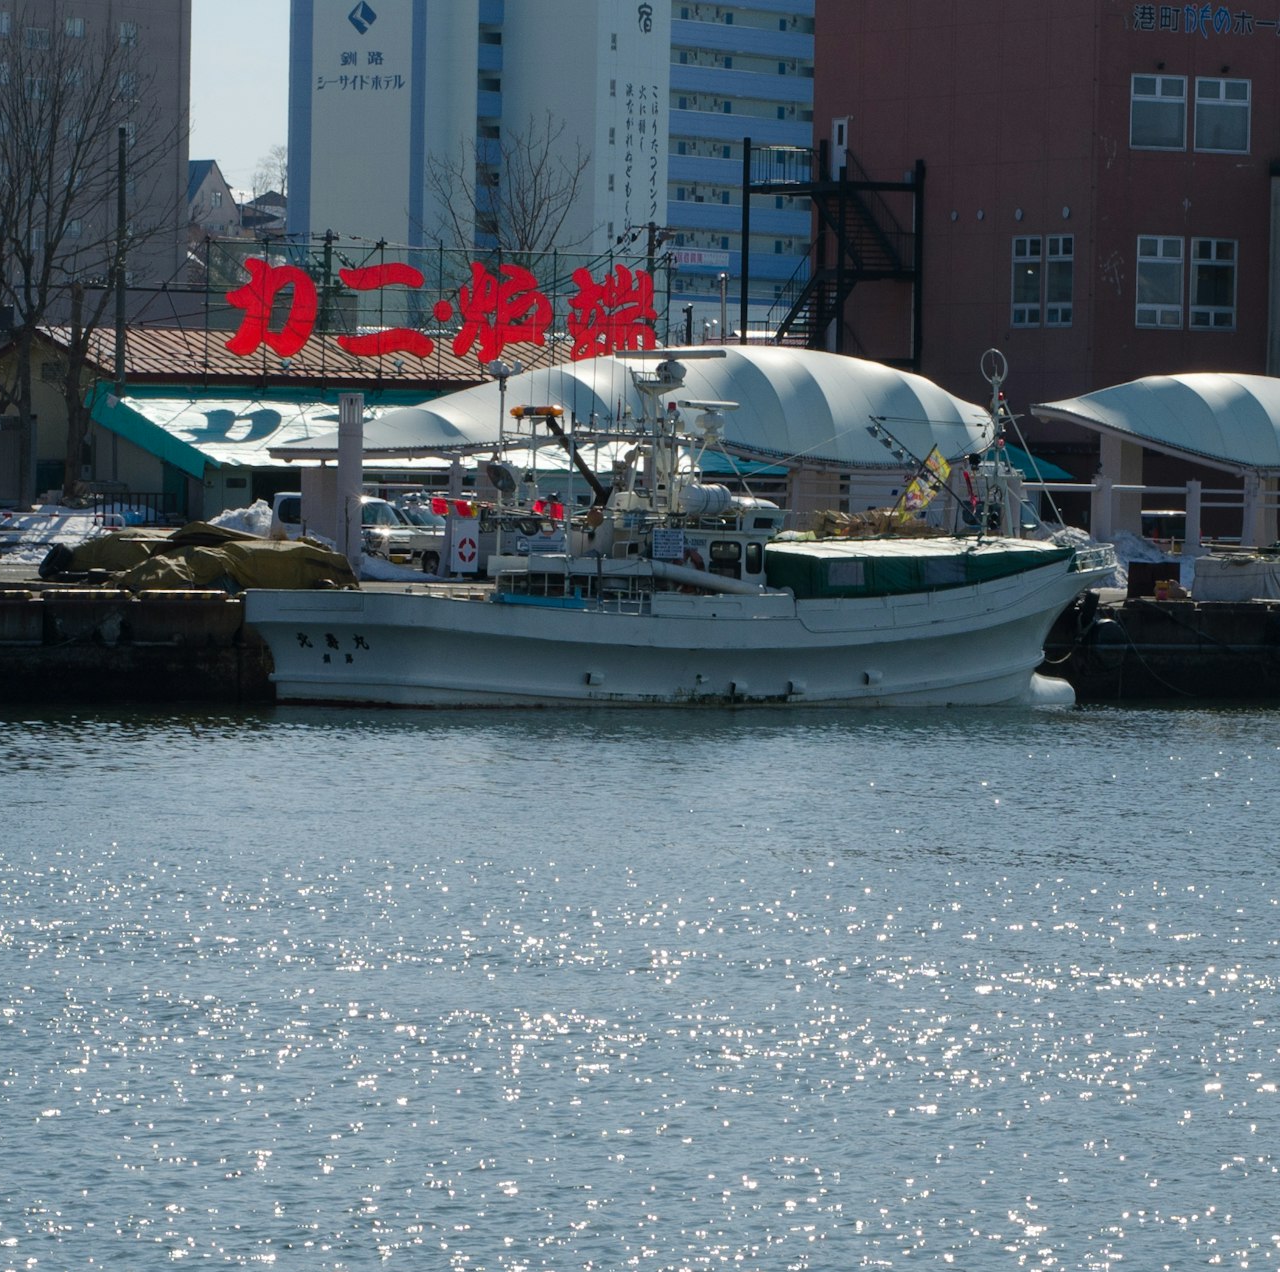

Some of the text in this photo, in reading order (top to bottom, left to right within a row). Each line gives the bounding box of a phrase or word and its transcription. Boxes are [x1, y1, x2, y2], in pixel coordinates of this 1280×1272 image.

[316, 75, 406, 91] シーサイドホテル
